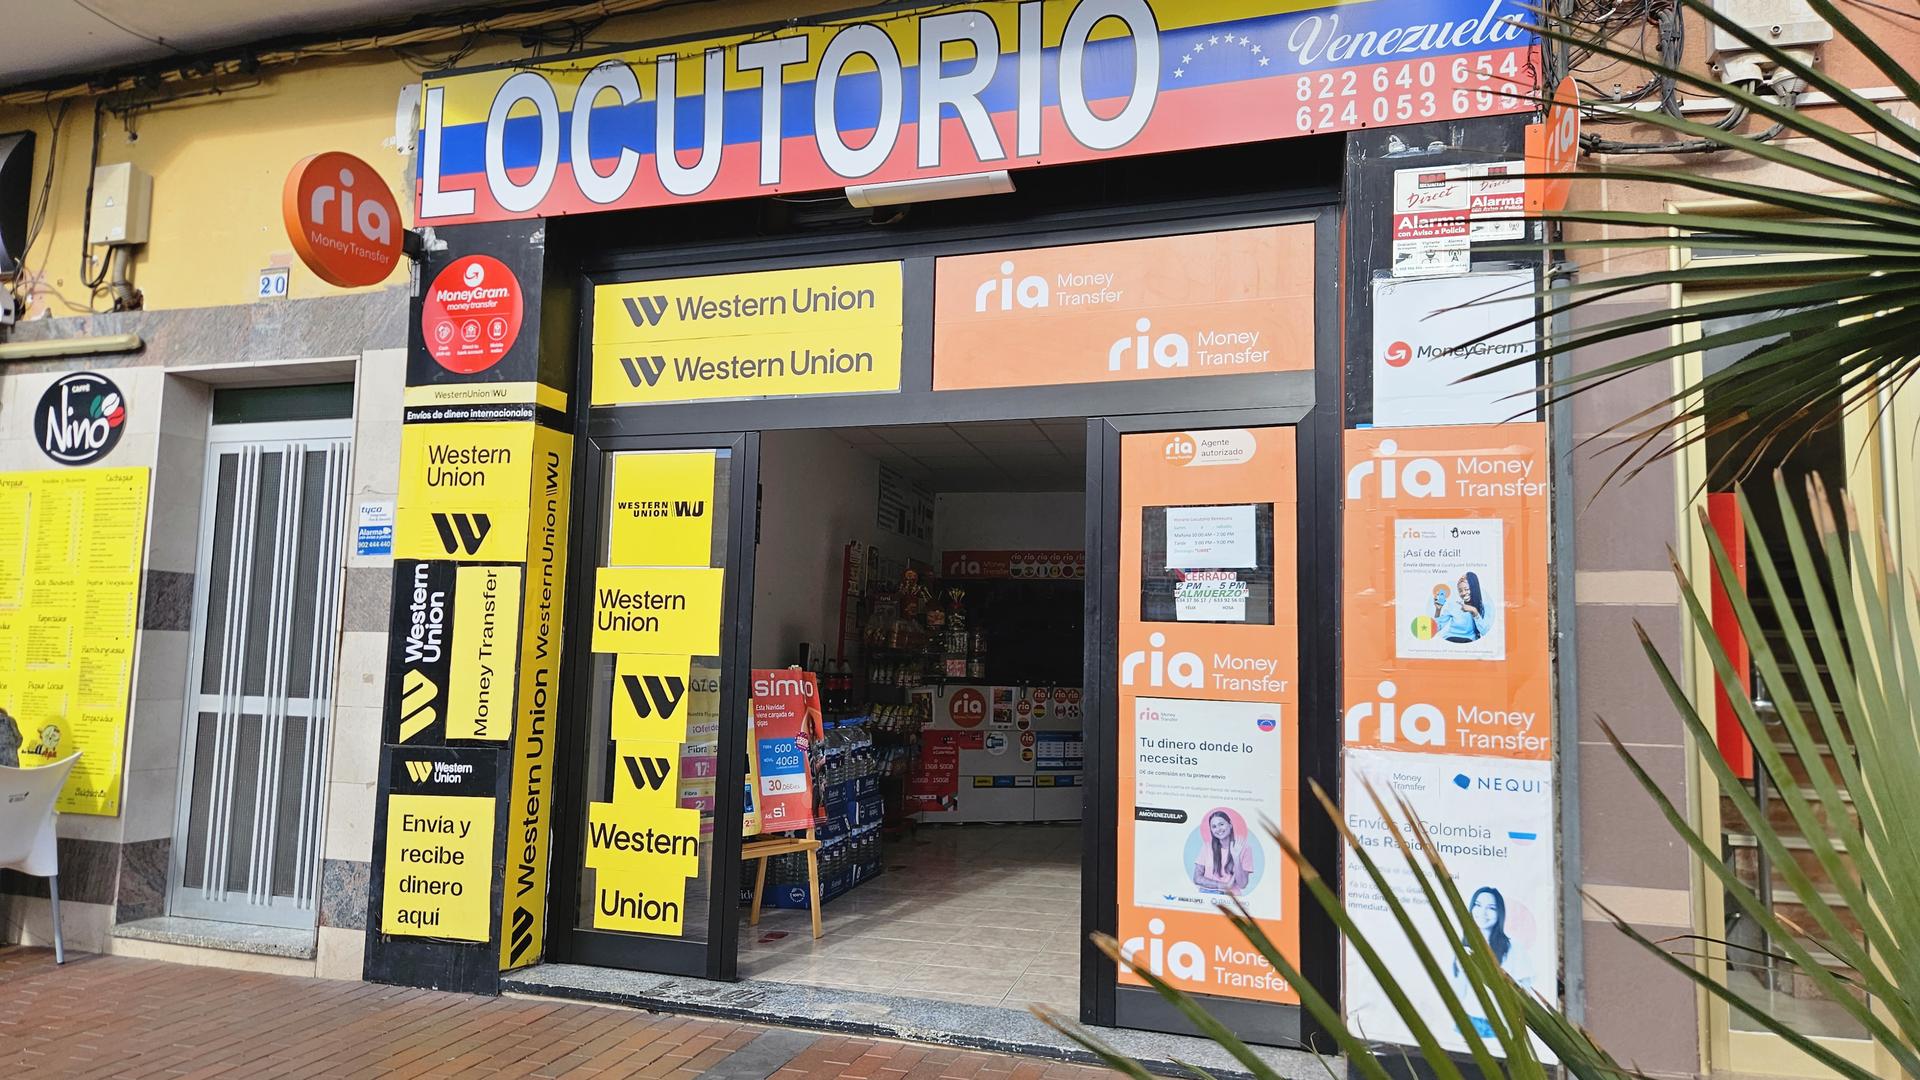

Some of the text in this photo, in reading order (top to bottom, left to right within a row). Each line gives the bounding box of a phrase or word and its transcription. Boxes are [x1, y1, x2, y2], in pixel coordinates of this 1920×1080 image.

[1287, 0, 1525, 65] Venezuela
[1295, 51, 1518, 102] 822 640 654
[419, 0, 1160, 218] LOCUTORIO
[1295, 102, 1358, 131] 624
[1372, 91, 1436, 124] 053
[311, 168, 390, 246] ria
[1471, 196, 1524, 207] Alarma
[1398, 215, 1466, 230] Alarma
[311, 231, 390, 265] Money Transfer
[261, 276, 285, 294] 20
[975, 260, 1049, 312] ria
[1057, 271, 1115, 290] Money
[436, 287, 508, 302] MoneyGram
[676, 285, 874, 321] Western Union
[1056, 288, 1124, 307] Transfer
[1108, 317, 1189, 371] ria
[1198, 329, 1260, 348] Money
[674, 347, 873, 382] Western Union
[1197, 348, 1270, 367] Transfer
[46, 384, 110, 453] Nino
[407, 408, 533, 420] Envíos de dinero internacionales
[1165, 436, 1193, 456] ria
[1201, 439, 1230, 448] Agente
[1201, 448, 1244, 457] autorizado
[429, 445, 511, 464] Western
[427, 466, 485, 486] Union
[1347, 438, 1446, 500] ria
[1456, 457, 1534, 478] Money
[1456, 479, 1547, 497] Transfer
[361, 506, 382, 514] tyco
[618, 501, 668, 509] WESTERN
[633, 510, 668, 518] UNION
[1402, 528, 1420, 539] ria
[1403, 548, 1461, 559] ¡Así de fácil!
[950, 554, 981, 575] ria
[1185, 572, 1236, 581] CERRADO
[598, 588, 686, 610] Western
[405, 563, 429, 663] Western
[597, 610, 658, 632] Union
[422, 591, 445, 663] Union
[473, 569, 497, 736] Money Transfer
[1122, 632, 1204, 689] ria
[1213, 653, 1278, 675] Money
[1212, 674, 1288, 692] Transfer
[953, 693, 982, 713] ria
[526, 668, 550, 759] Union
[1140, 707, 1159, 721] ria
[1345, 680, 1446, 747] ria
[1456, 705, 1536, 731] Money
[774, 743, 792, 754] 600
[1140, 737, 1254, 754] Tu dinero donde lo
[1455, 728, 1550, 751] Transfer
[434, 761, 473, 774] Western
[775, 756, 799, 767] 40GB
[1139, 753, 1198, 766] necesitas
[433, 772, 462, 784] Union
[1392, 772, 1422, 783] Money
[1392, 781, 1427, 792] Transfer
[1477, 777, 1541, 793] NEQUI
[402, 814, 472, 839] Envía y
[516, 764, 542, 898] Western
[1404, 823, 1412, 833] a
[589, 821, 699, 858] Western
[1437, 841, 1508, 858] Imposible!
[401, 846, 465, 865] recibe
[399, 875, 463, 896] dinero
[600, 887, 679, 923] Union
[397, 908, 440, 929] aquí
[1120, 918, 1206, 982] ria
